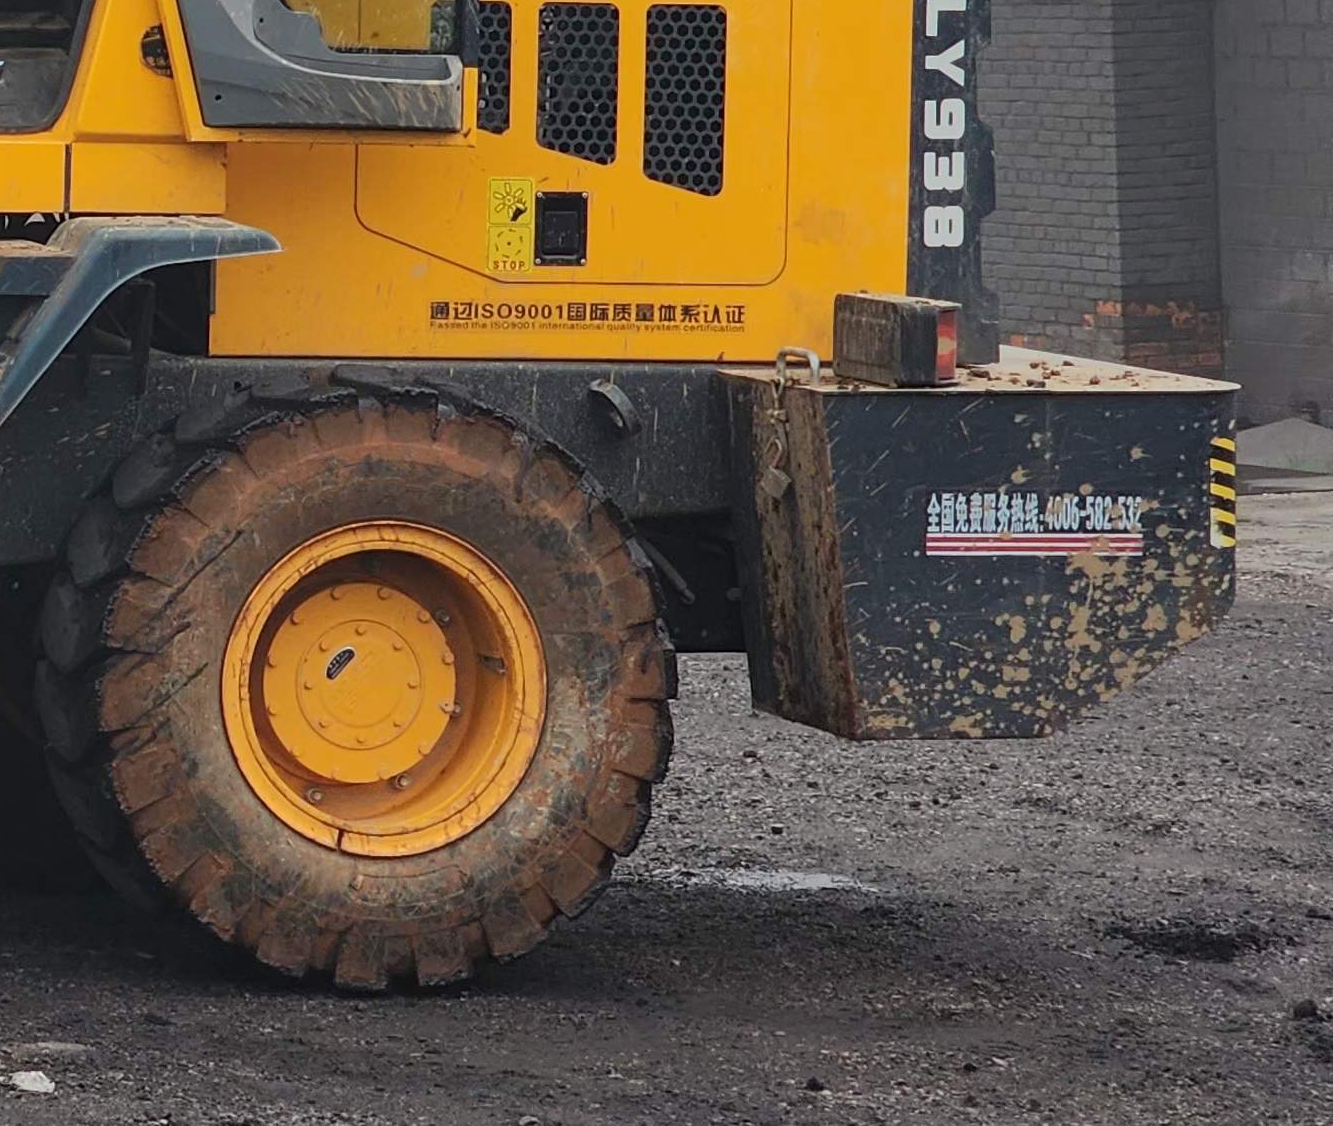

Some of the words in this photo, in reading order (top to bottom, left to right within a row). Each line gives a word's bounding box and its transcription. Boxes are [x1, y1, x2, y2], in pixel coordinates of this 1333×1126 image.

[493, 260, 526, 270] STOP
[430, 302, 746, 324] 通过ISO9001国际质量体系认证
[926, 492, 1143, 534] 全国免费服务热线:4006-582532
